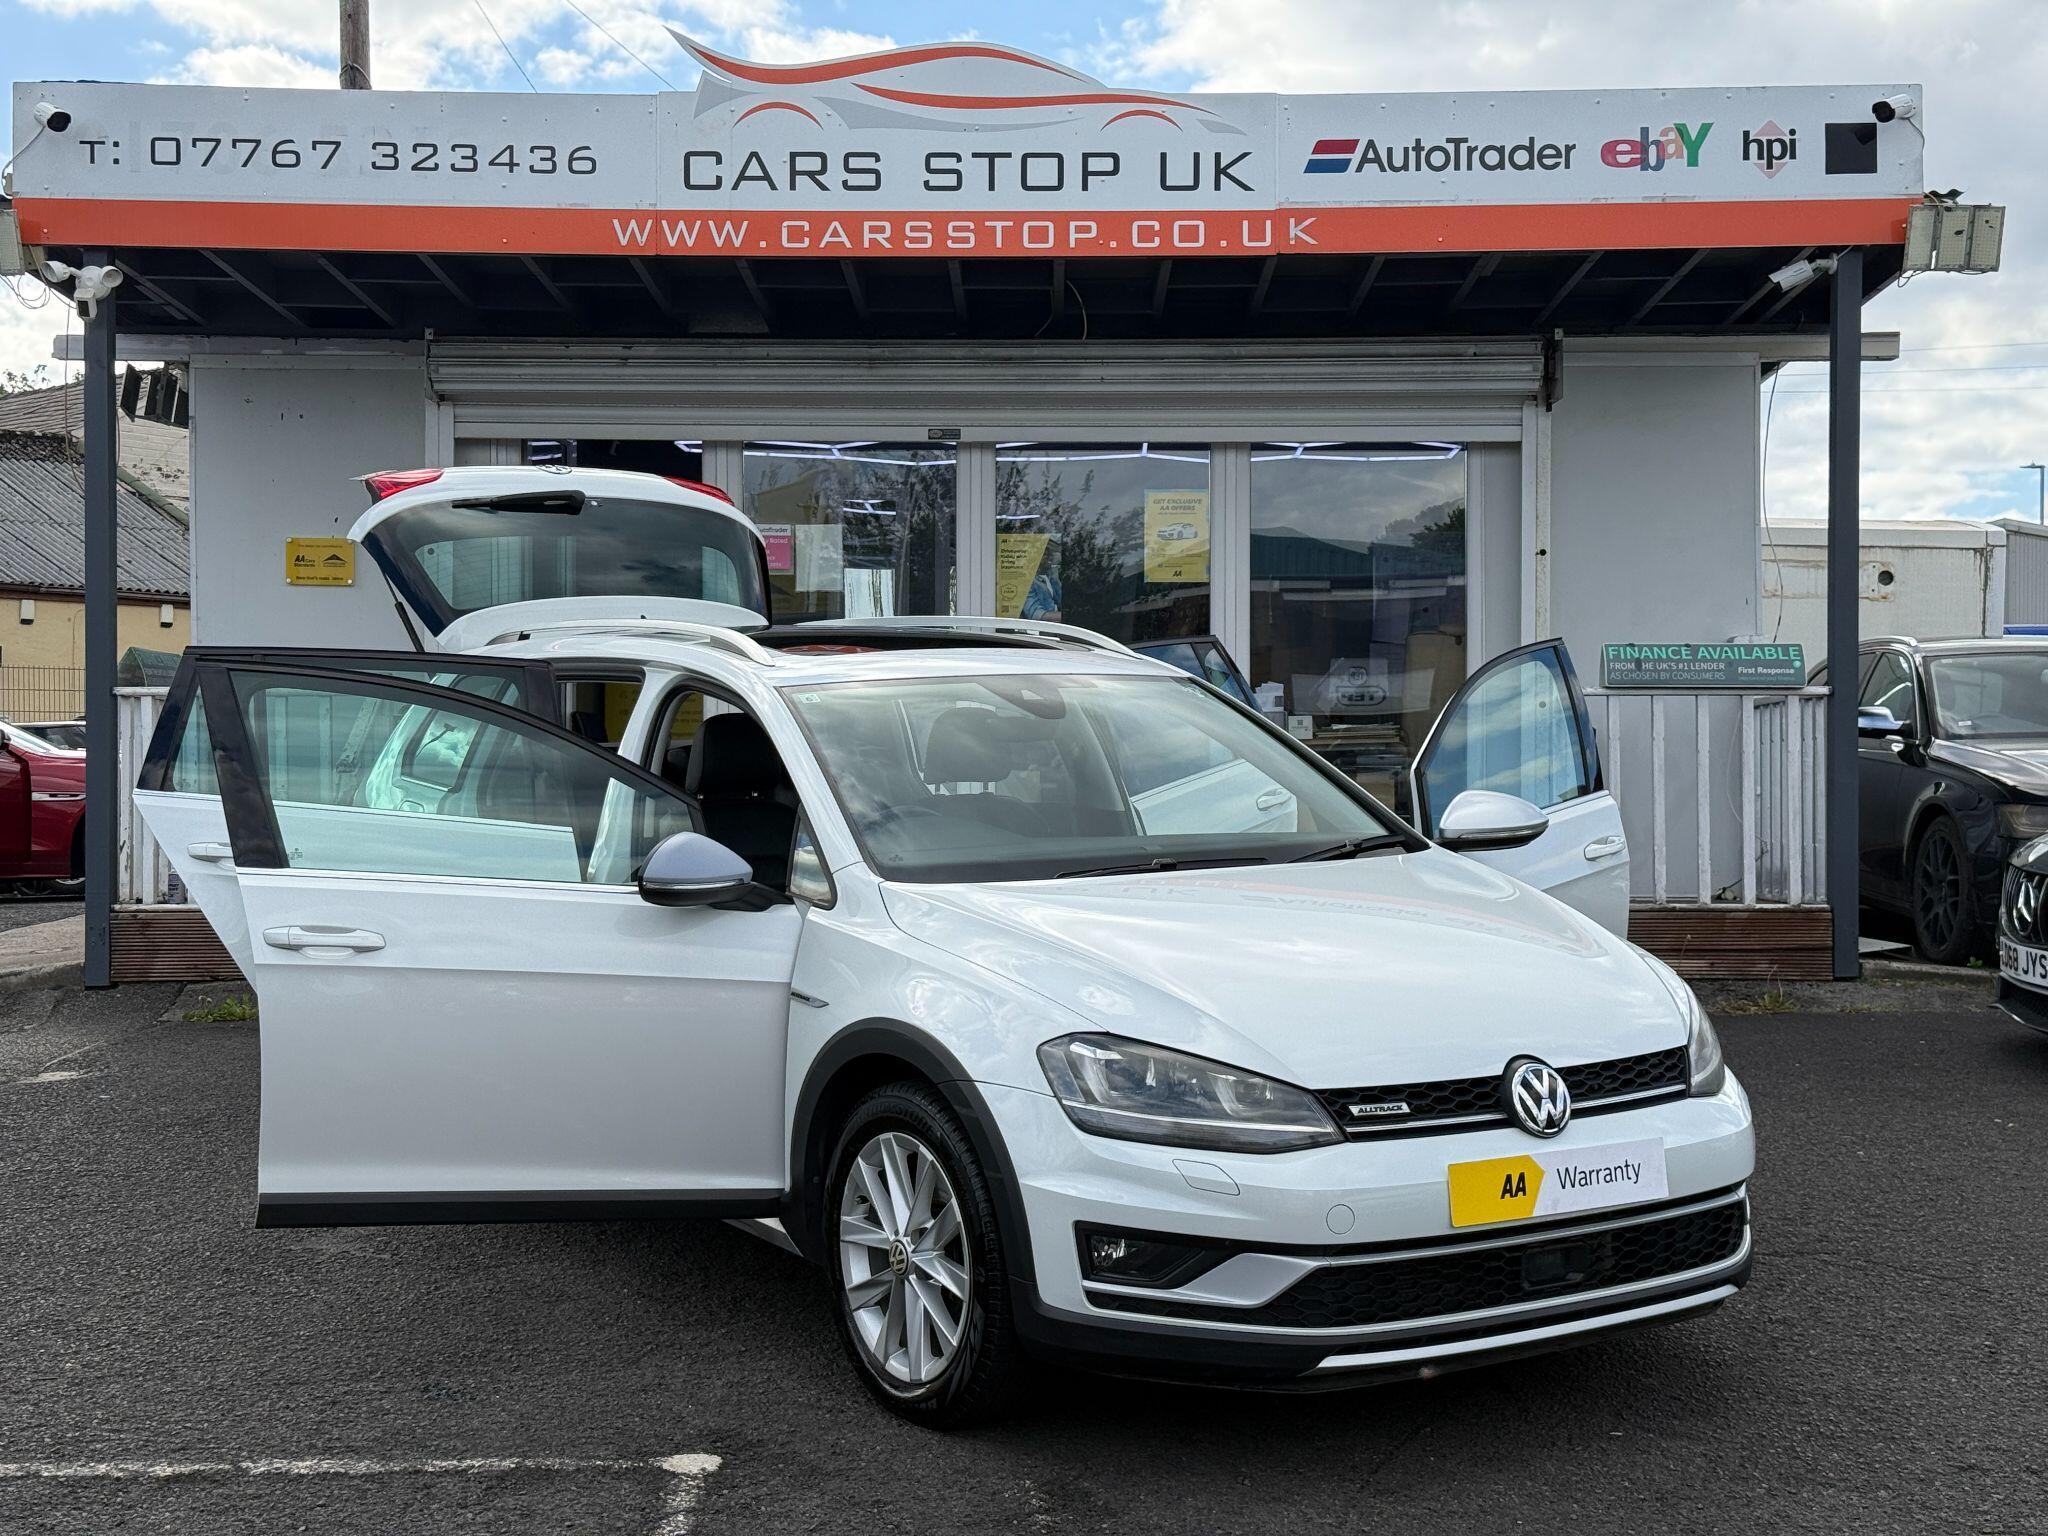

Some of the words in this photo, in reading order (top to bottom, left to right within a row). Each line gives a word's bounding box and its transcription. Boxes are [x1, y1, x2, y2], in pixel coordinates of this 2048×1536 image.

[150, 136, 342, 170] 07767
[371, 141, 597, 175] 323436
[1355, 135, 1577, 173] AutoTrader
[1742, 128, 1797, 170] hpi
[683, 150, 882, 192] CARS
[923, 151, 1120, 192] STOP
[1159, 151, 1256, 192] UK
[612, 217, 1318, 250] WWW.CARSSTOP.CO.UK
[1608, 646, 1693, 660] FINANCE
[1697, 646, 1801, 660] AVAILABLE
[1609, 661, 1636, 671] FROM
[1637, 661, 1655, 671] HE
[1656, 661, 1678, 671] UK'S
[1690, 662, 1726, 671] LENDER
[1609, 671, 1621, 681] AS
[1622, 671, 1659, 681] CHOSEN
[1660, 671, 1671, 681] BY
[1672, 671, 1726, 681] CONSUMERS
[1738, 666, 1756, 675] First
[1757, 666, 1795, 676] Response
[1357, 1104, 1404, 1115] ALLTRACK
[1500, 1171, 1528, 1200] AA
[1556, 1158, 1641, 1191] Warranty
